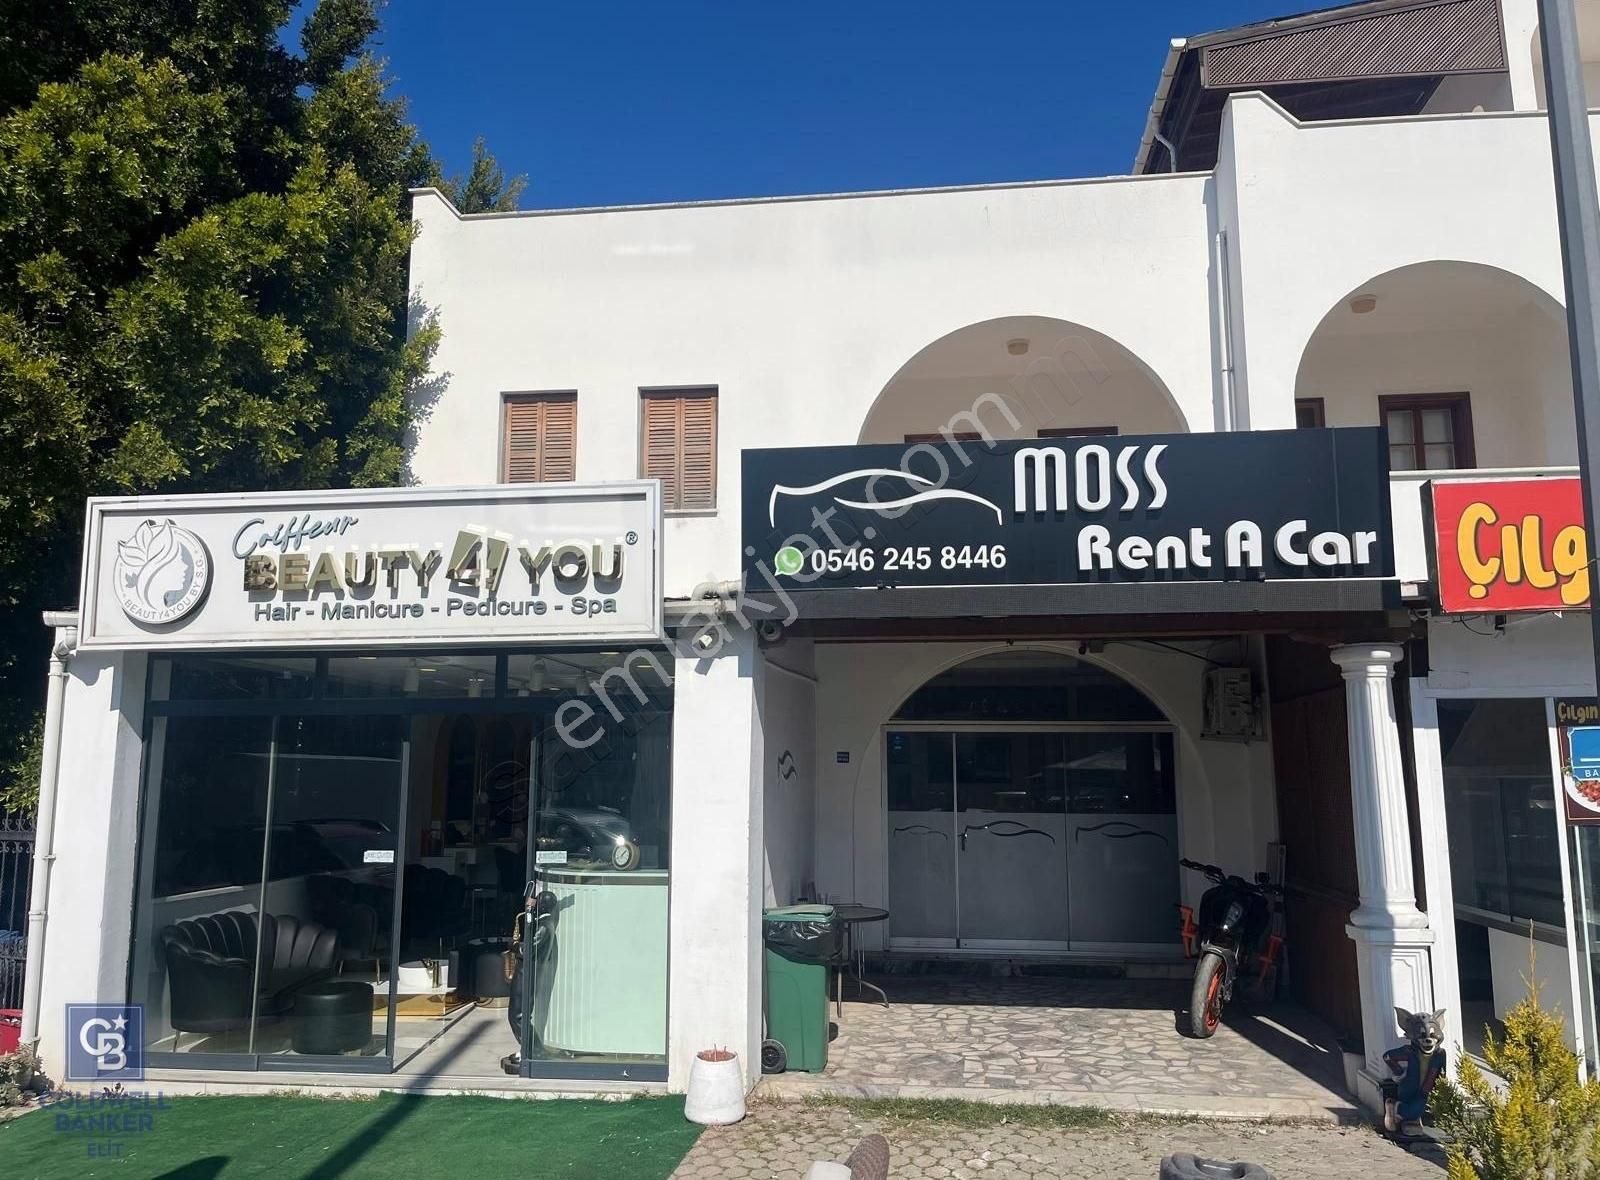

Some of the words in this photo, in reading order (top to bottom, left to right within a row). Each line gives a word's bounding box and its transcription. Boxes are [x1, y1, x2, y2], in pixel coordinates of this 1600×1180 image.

[1014, 444, 1168, 513] MOSS
[232, 513, 359, 559] Coiffeur
[811, 548, 875, 572] 0546
[883, 546, 932, 571] 245
[940, 544, 1007, 569] 8446
[1077, 524, 1212, 570] Rent
[1225, 520, 1263, 567] A
[1274, 520, 1377, 566] Car
[254, 602, 301, 621] Hair
[321, 601, 425, 620] Manicure
[447, 598, 548, 616] Pedicure
[571, 596, 617, 618] Spa
